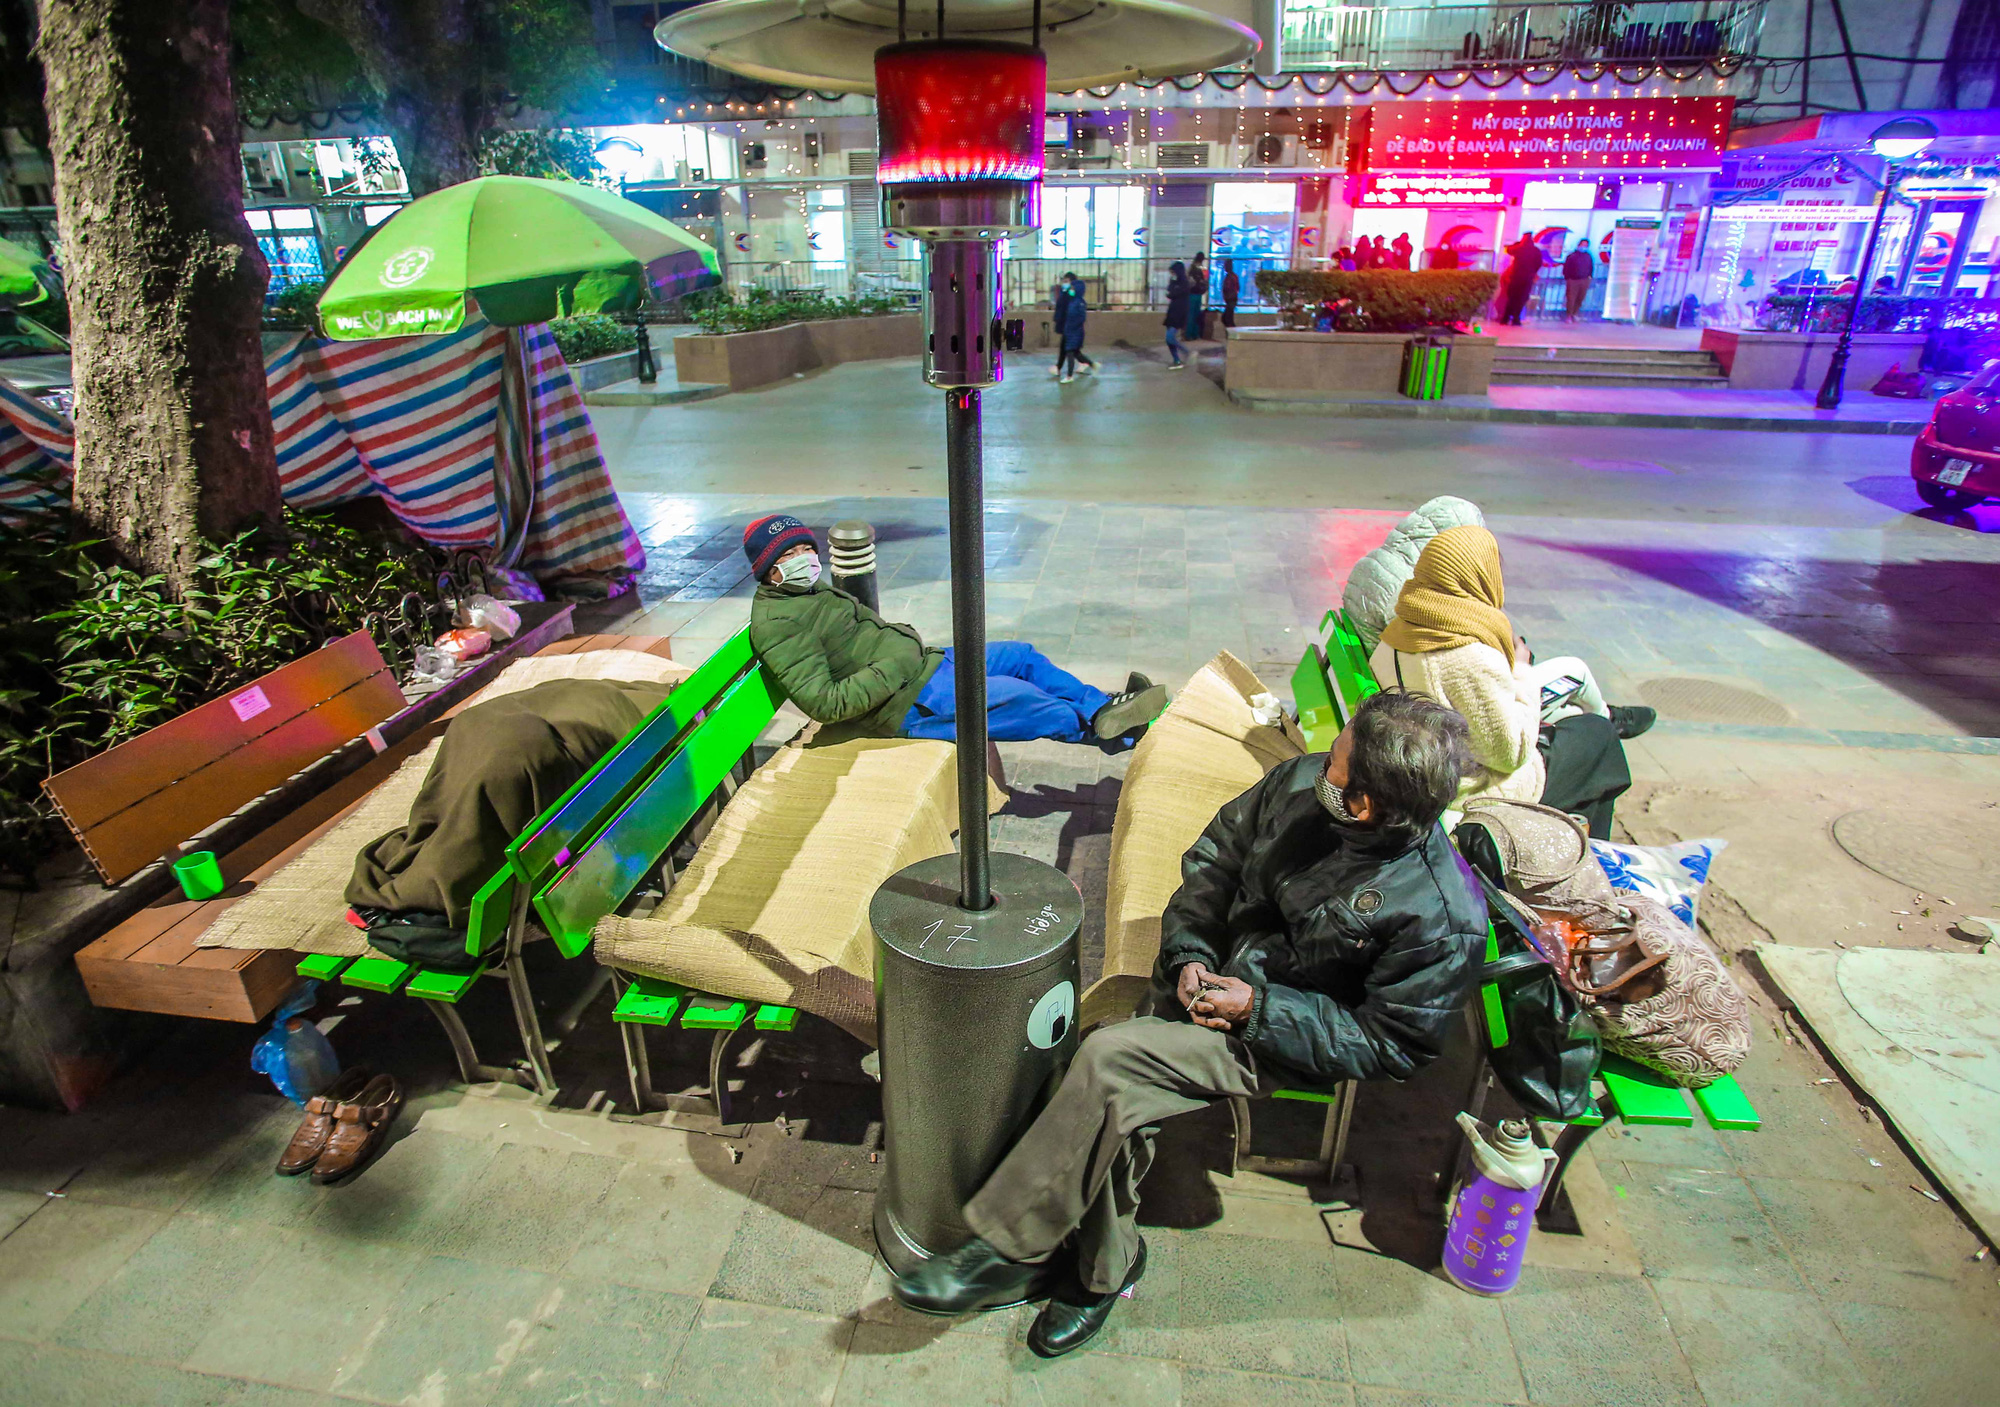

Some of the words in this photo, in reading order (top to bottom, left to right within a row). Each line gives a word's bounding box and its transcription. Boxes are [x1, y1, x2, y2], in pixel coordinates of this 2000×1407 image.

[1575, 116, 1624, 129] TRANG
[1611, 139, 1651, 153] XUNG
[1653, 138, 1707, 152] QUANH
[1817, 177, 1833, 188] A9
[336, 316, 364, 331] WE
[919, 919, 978, 952] 17
